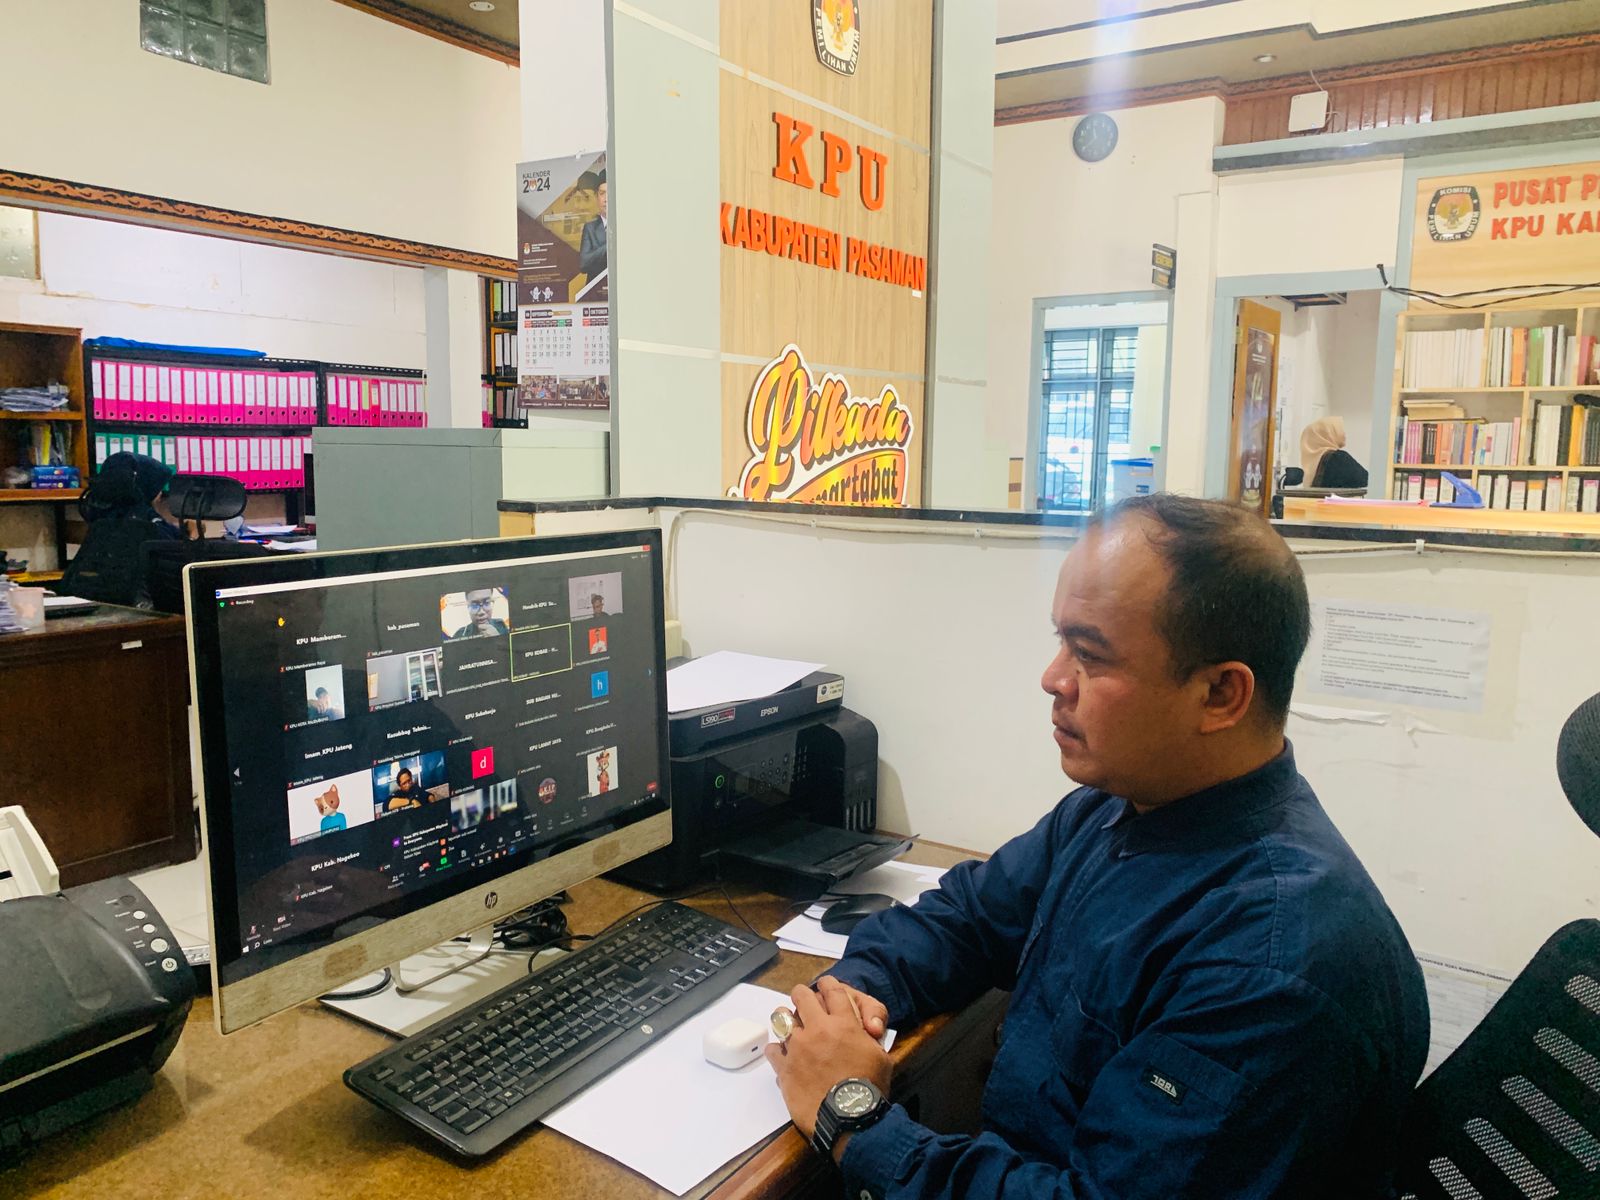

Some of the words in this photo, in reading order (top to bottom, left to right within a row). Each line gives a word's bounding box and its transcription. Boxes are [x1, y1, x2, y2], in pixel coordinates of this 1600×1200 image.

[815, 7, 846, 72] PEMILIHAN
[848, 31, 860, 73] UMUM
[522, 170, 551, 180] KALENDER
[772, 111, 888, 212] KPU
[1493, 175, 1572, 209] PUSAT
[1581, 174, 1600, 201] P
[1491, 214, 1545, 240] KPU
[1555, 210, 1600, 236] KA
[719, 202, 842, 272] KABUPATEN
[846, 235, 926, 291] PASAMAN
[745, 349, 910, 490] Pilkada
[597, 679, 603, 690] h
[760, 705, 779, 717] EPSON
[480, 756, 487, 769] d
[311, 863, 323, 872] KPU
[324, 859, 336, 869] Kab.
